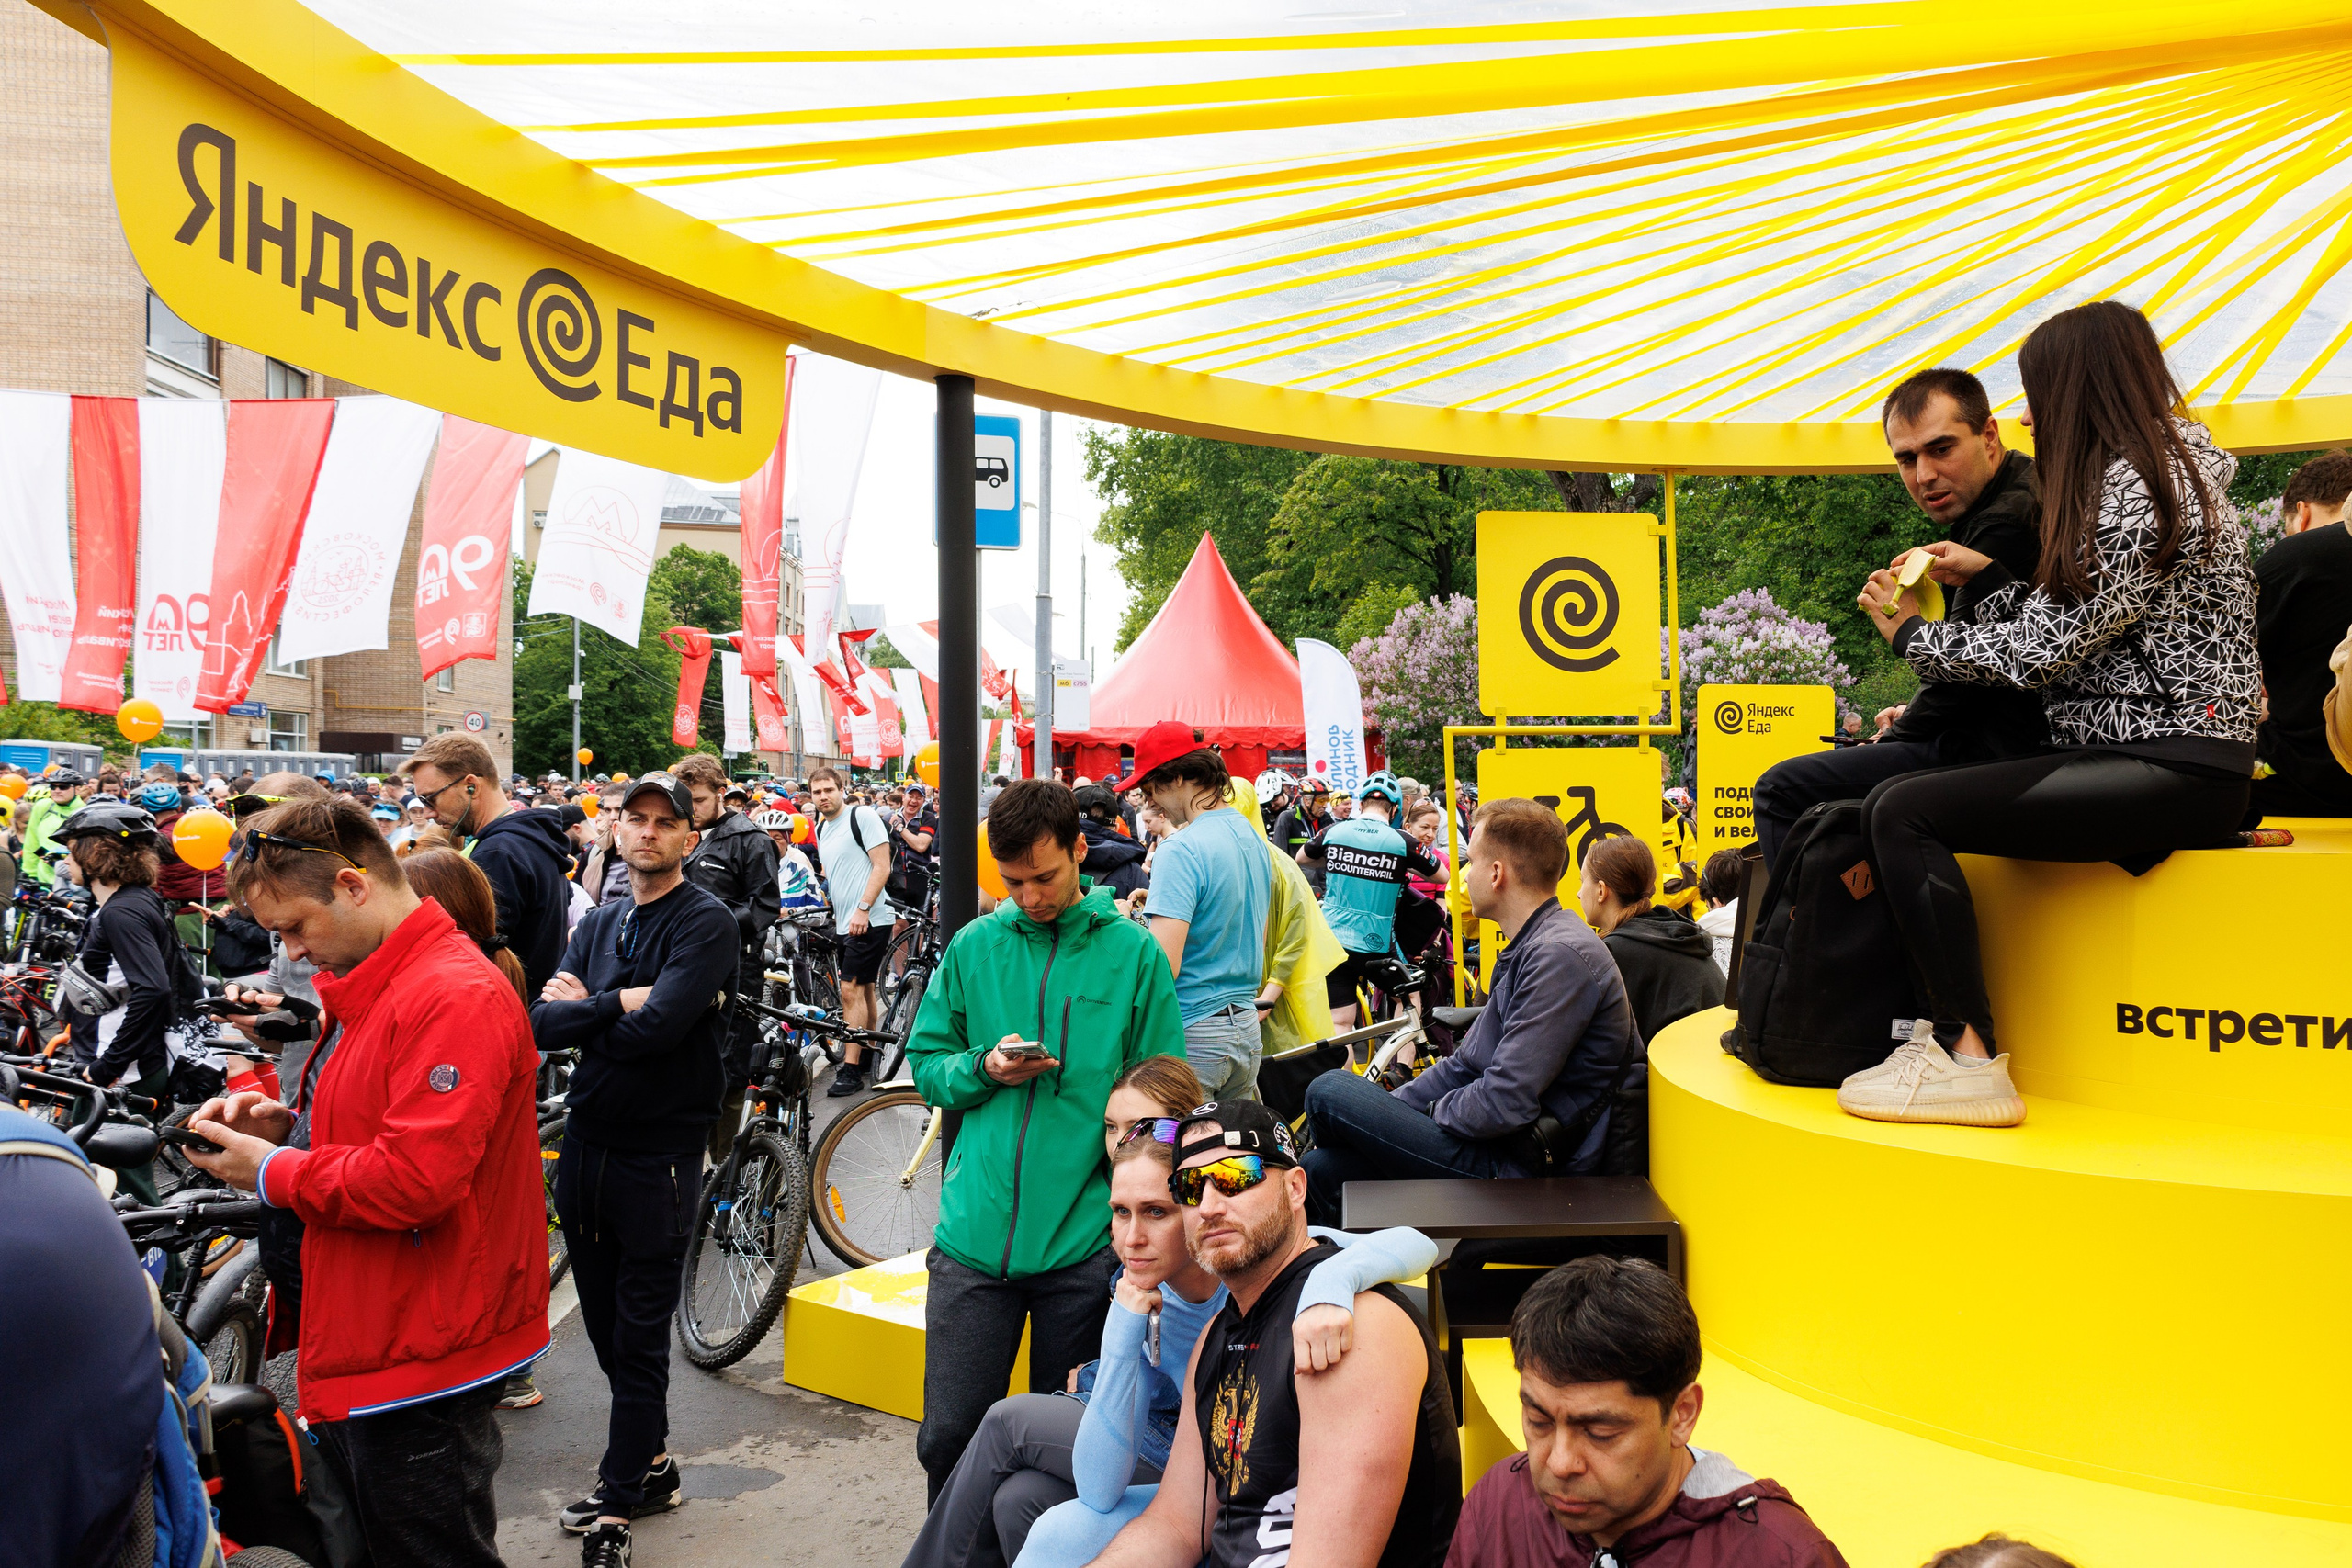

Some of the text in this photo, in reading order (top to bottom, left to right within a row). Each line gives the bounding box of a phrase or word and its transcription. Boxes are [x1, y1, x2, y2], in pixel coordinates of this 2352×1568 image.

[173, 122, 744, 438] Яндекс Еда
[1747, 703, 1795, 717] Яндекс
[468, 718, 481, 727] 40
[1747, 720, 1771, 734] Еда
[1714, 826, 1725, 838] и
[1327, 847, 1398, 870] Bianchi
[1334, 862, 1394, 880] COUNTERVAIL
